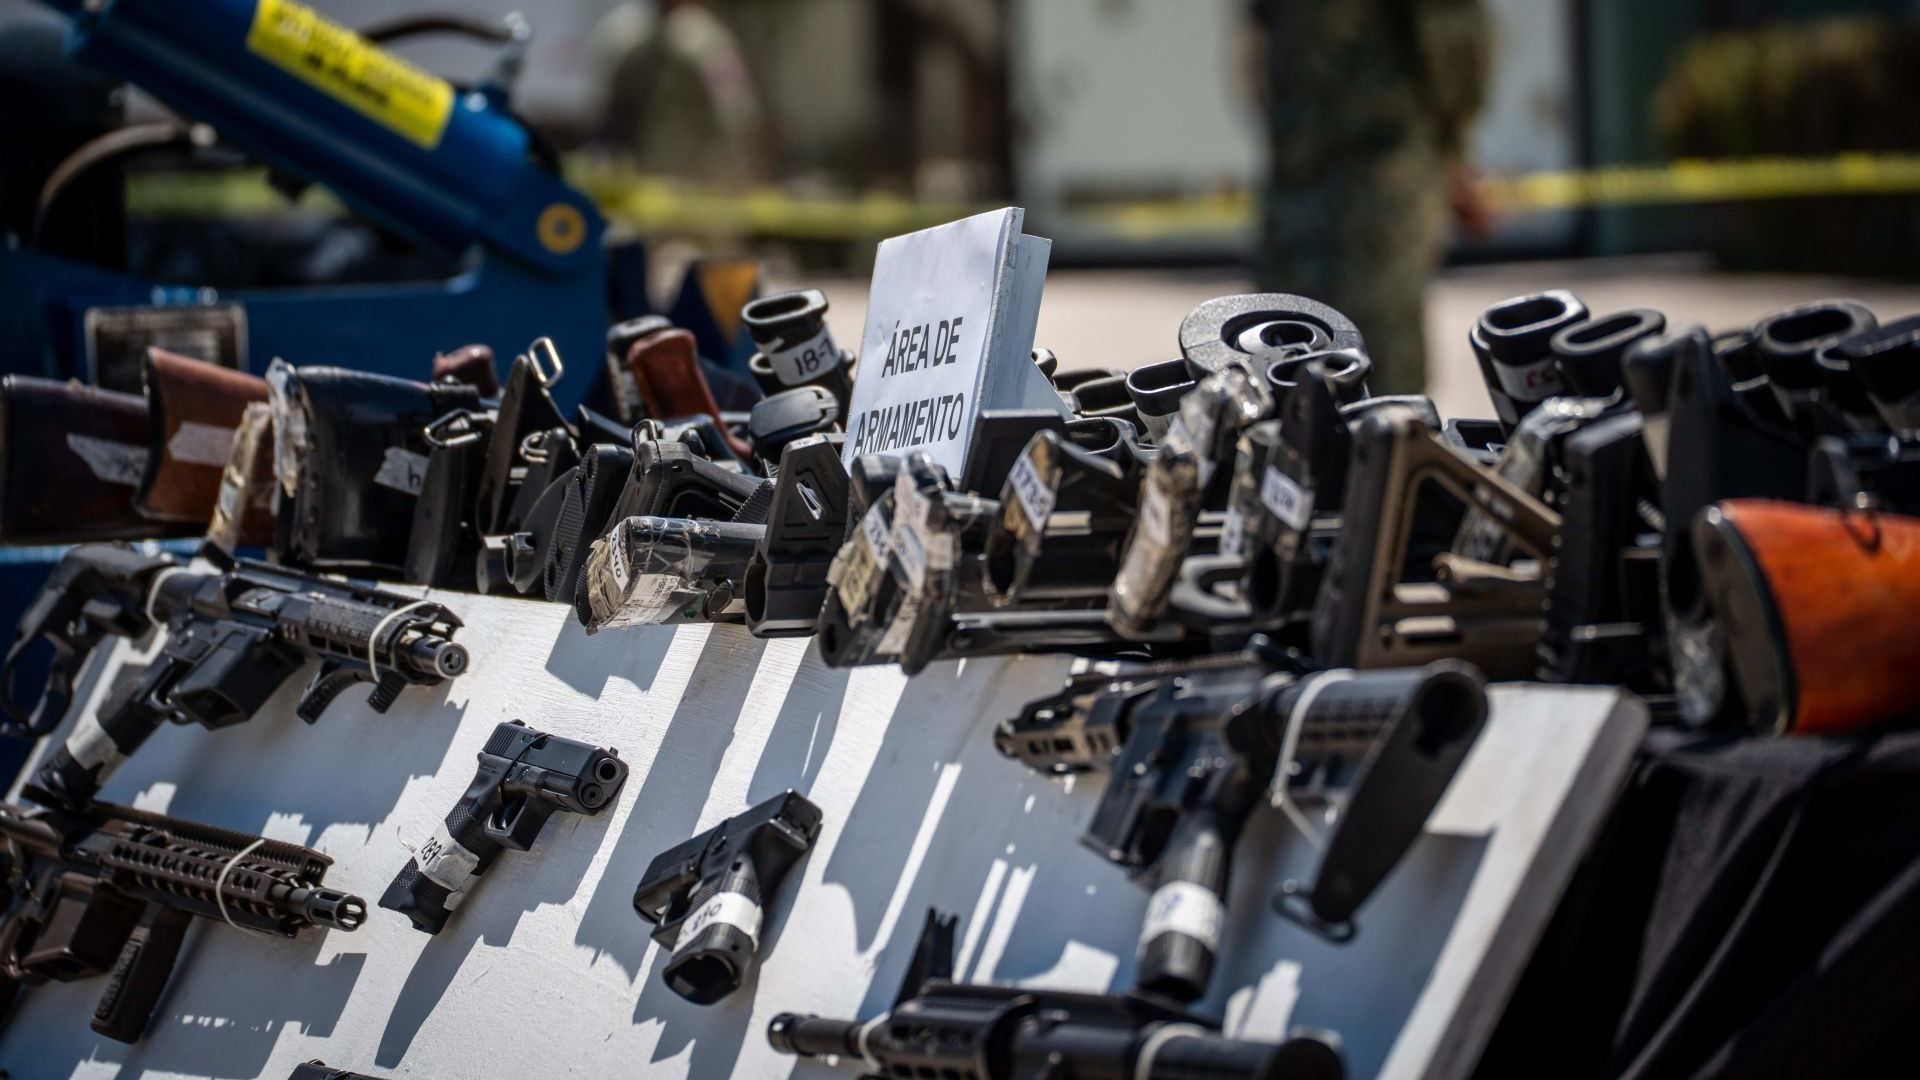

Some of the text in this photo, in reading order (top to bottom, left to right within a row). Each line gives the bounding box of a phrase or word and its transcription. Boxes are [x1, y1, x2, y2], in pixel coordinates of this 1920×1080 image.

[880, 316, 964, 378] ÁREA DE
[851, 392, 964, 458] ARMAMENTO
[421, 836, 442, 866] 289
